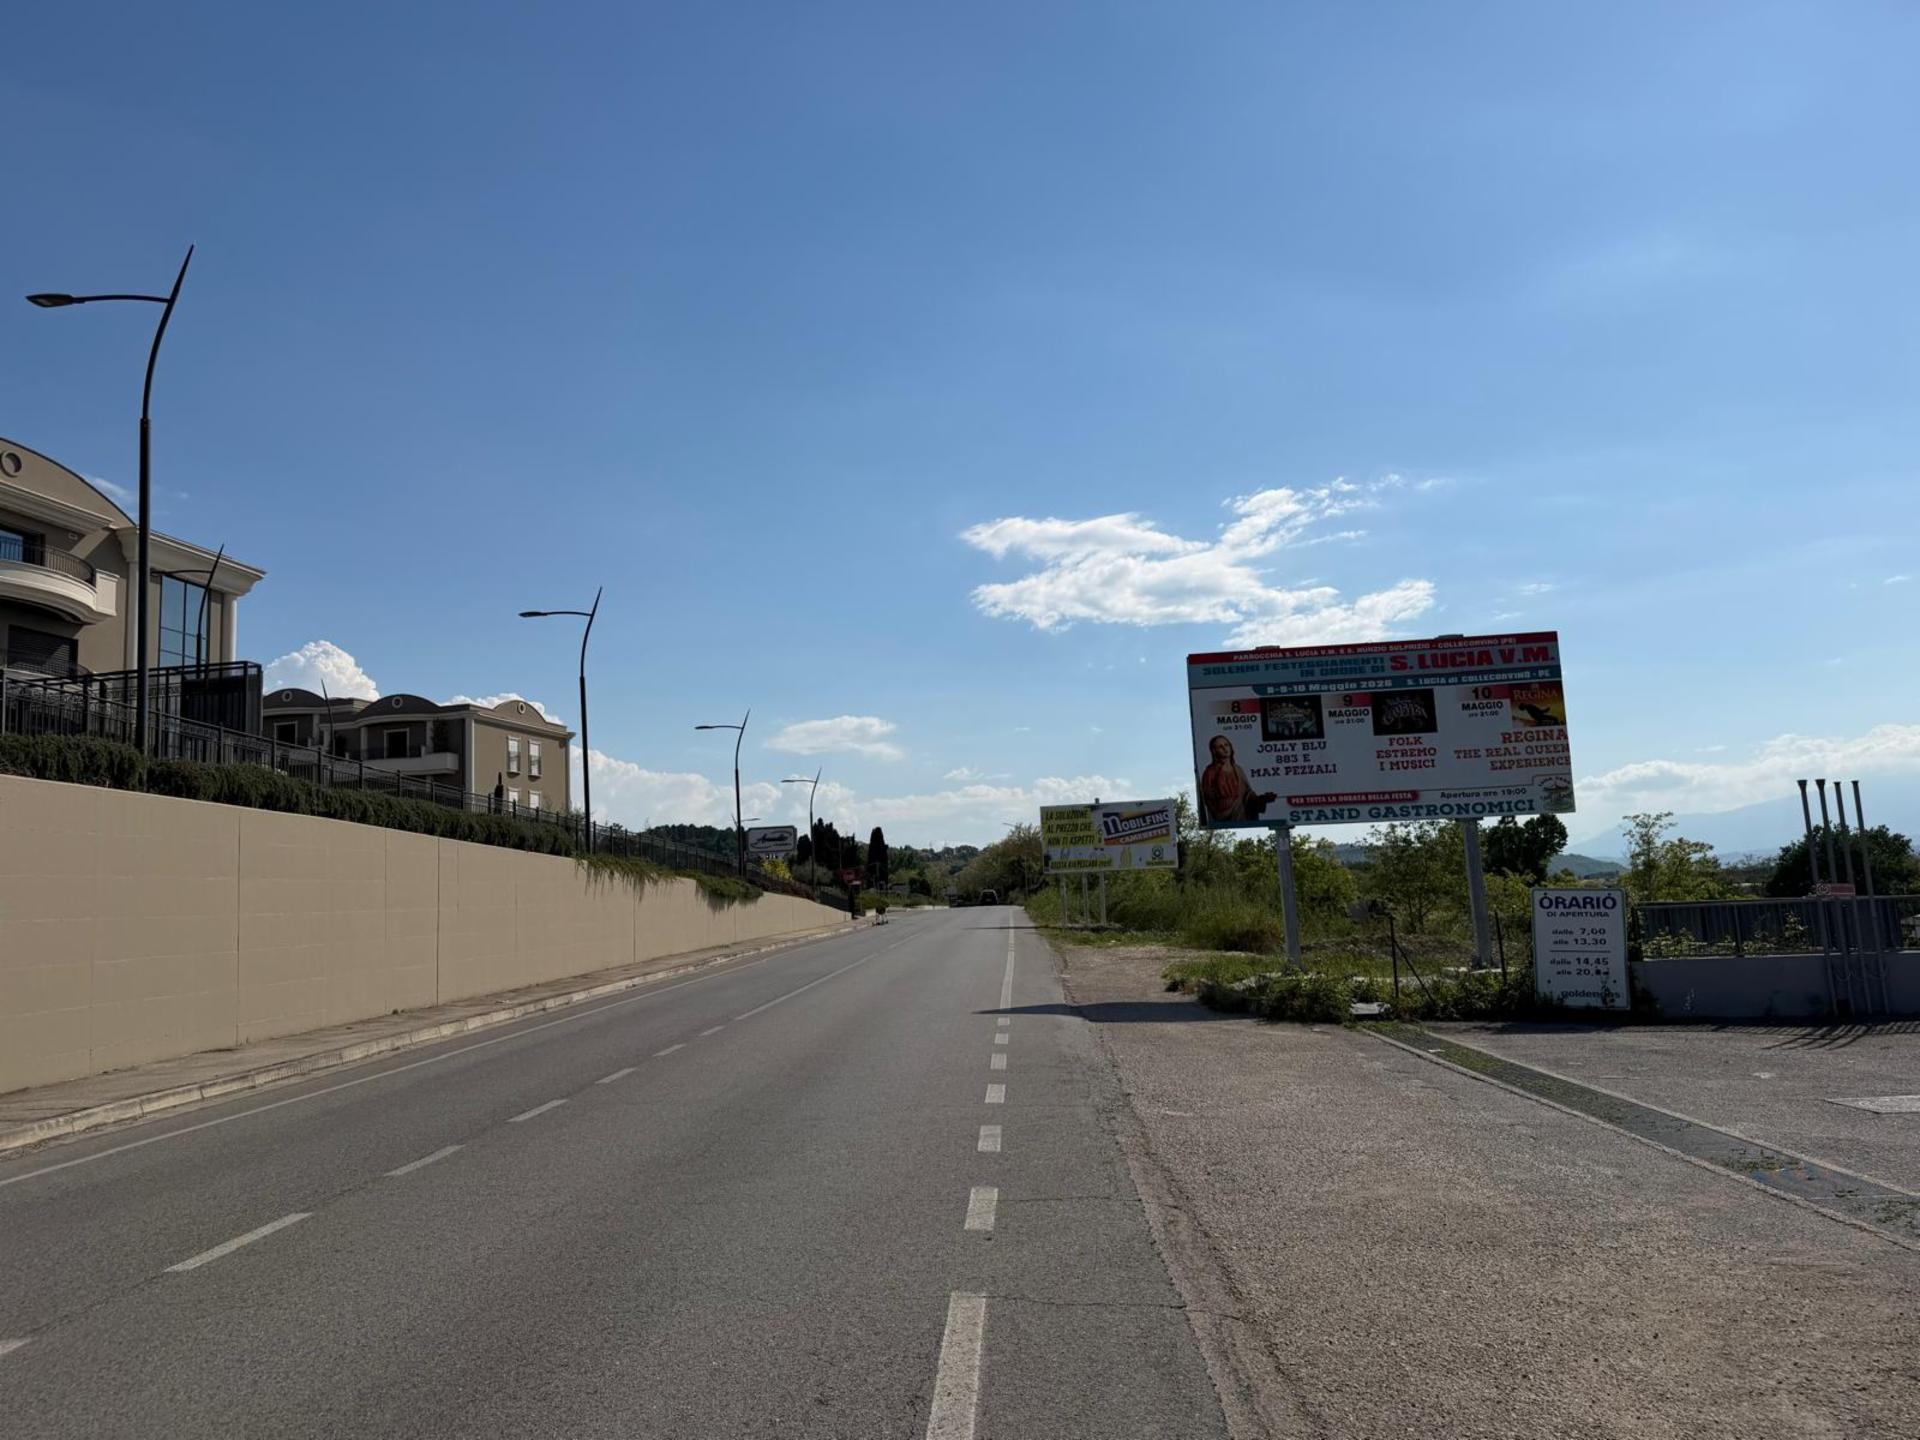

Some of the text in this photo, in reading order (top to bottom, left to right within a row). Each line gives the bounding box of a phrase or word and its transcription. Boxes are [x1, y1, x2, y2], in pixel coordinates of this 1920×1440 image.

[1296, 650, 1318, 658] LUCIA
[1390, 646, 1555, 670] S. LUCIA V.M.
[1309, 682, 1357, 692] Maggio
[1420, 677, 1446, 685] LUCIA
[1472, 688, 1491, 698] 10
[1343, 694, 1352, 706] 9
[1462, 701, 1504, 710] MAGGIO
[1231, 701, 1240, 713] 8
[1328, 708, 1370, 718] MAGGIO
[1217, 715, 1258, 724] MAGGIO
[1389, 736, 1423, 746] FOLK
[1501, 729, 1568, 744] REGINA
[1257, 741, 1327, 754] JOLLY BLU
[1376, 747, 1437, 759] ESTREMO
[1454, 743, 1570, 759] THE REAL QUEEN
[1276, 754, 1312, 764] 883 E
[1490, 756, 1571, 770] EXPERIENCE
[1250, 764, 1337, 778] MAX PEZZALI
[1379, 760, 1436, 772] I MUSICI
[1440, 790, 1480, 799] Apertura
[1290, 799, 1535, 822] STAND GASTRONOMICI
[1539, 896, 1617, 910] ORARIO
